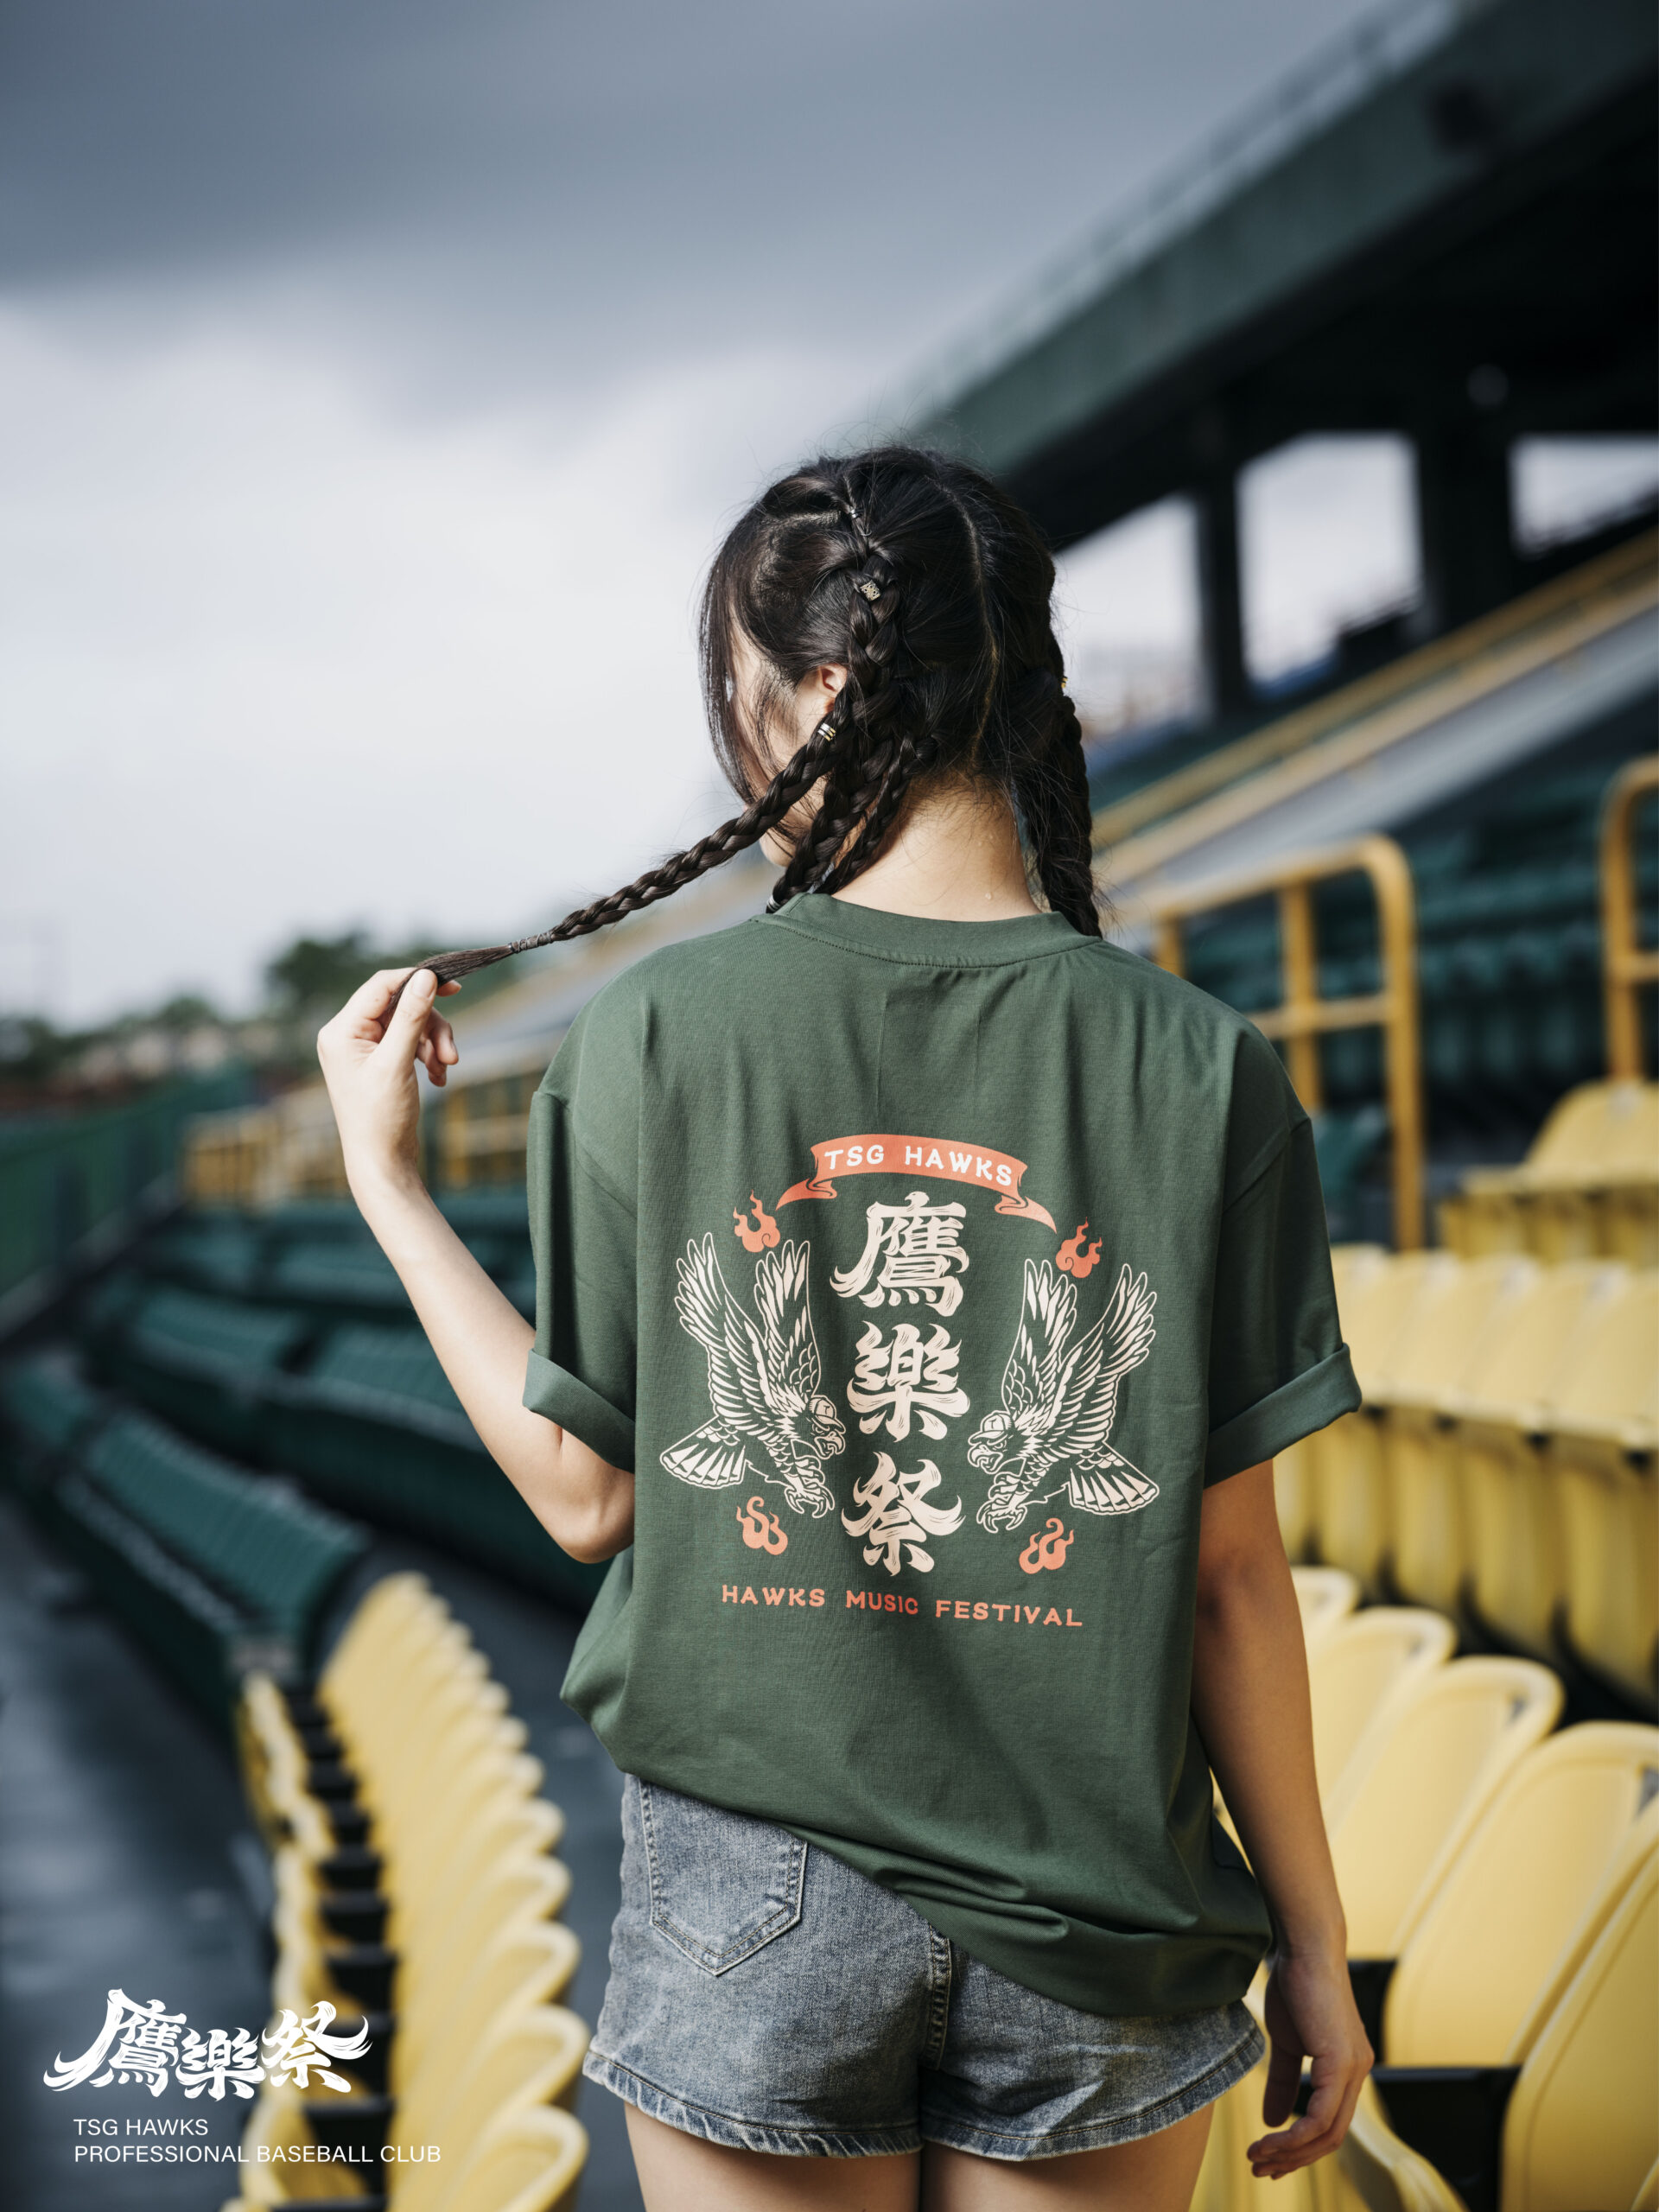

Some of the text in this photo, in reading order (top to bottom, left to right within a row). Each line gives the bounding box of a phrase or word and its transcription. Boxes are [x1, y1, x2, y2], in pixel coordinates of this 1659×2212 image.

[823, 1144, 1013, 1187] TSG HAWKS
[830, 1191, 970, 1576] 鷹樂祭
[721, 1585, 1083, 1626] HAWKS MUSIC FESTIVAL
